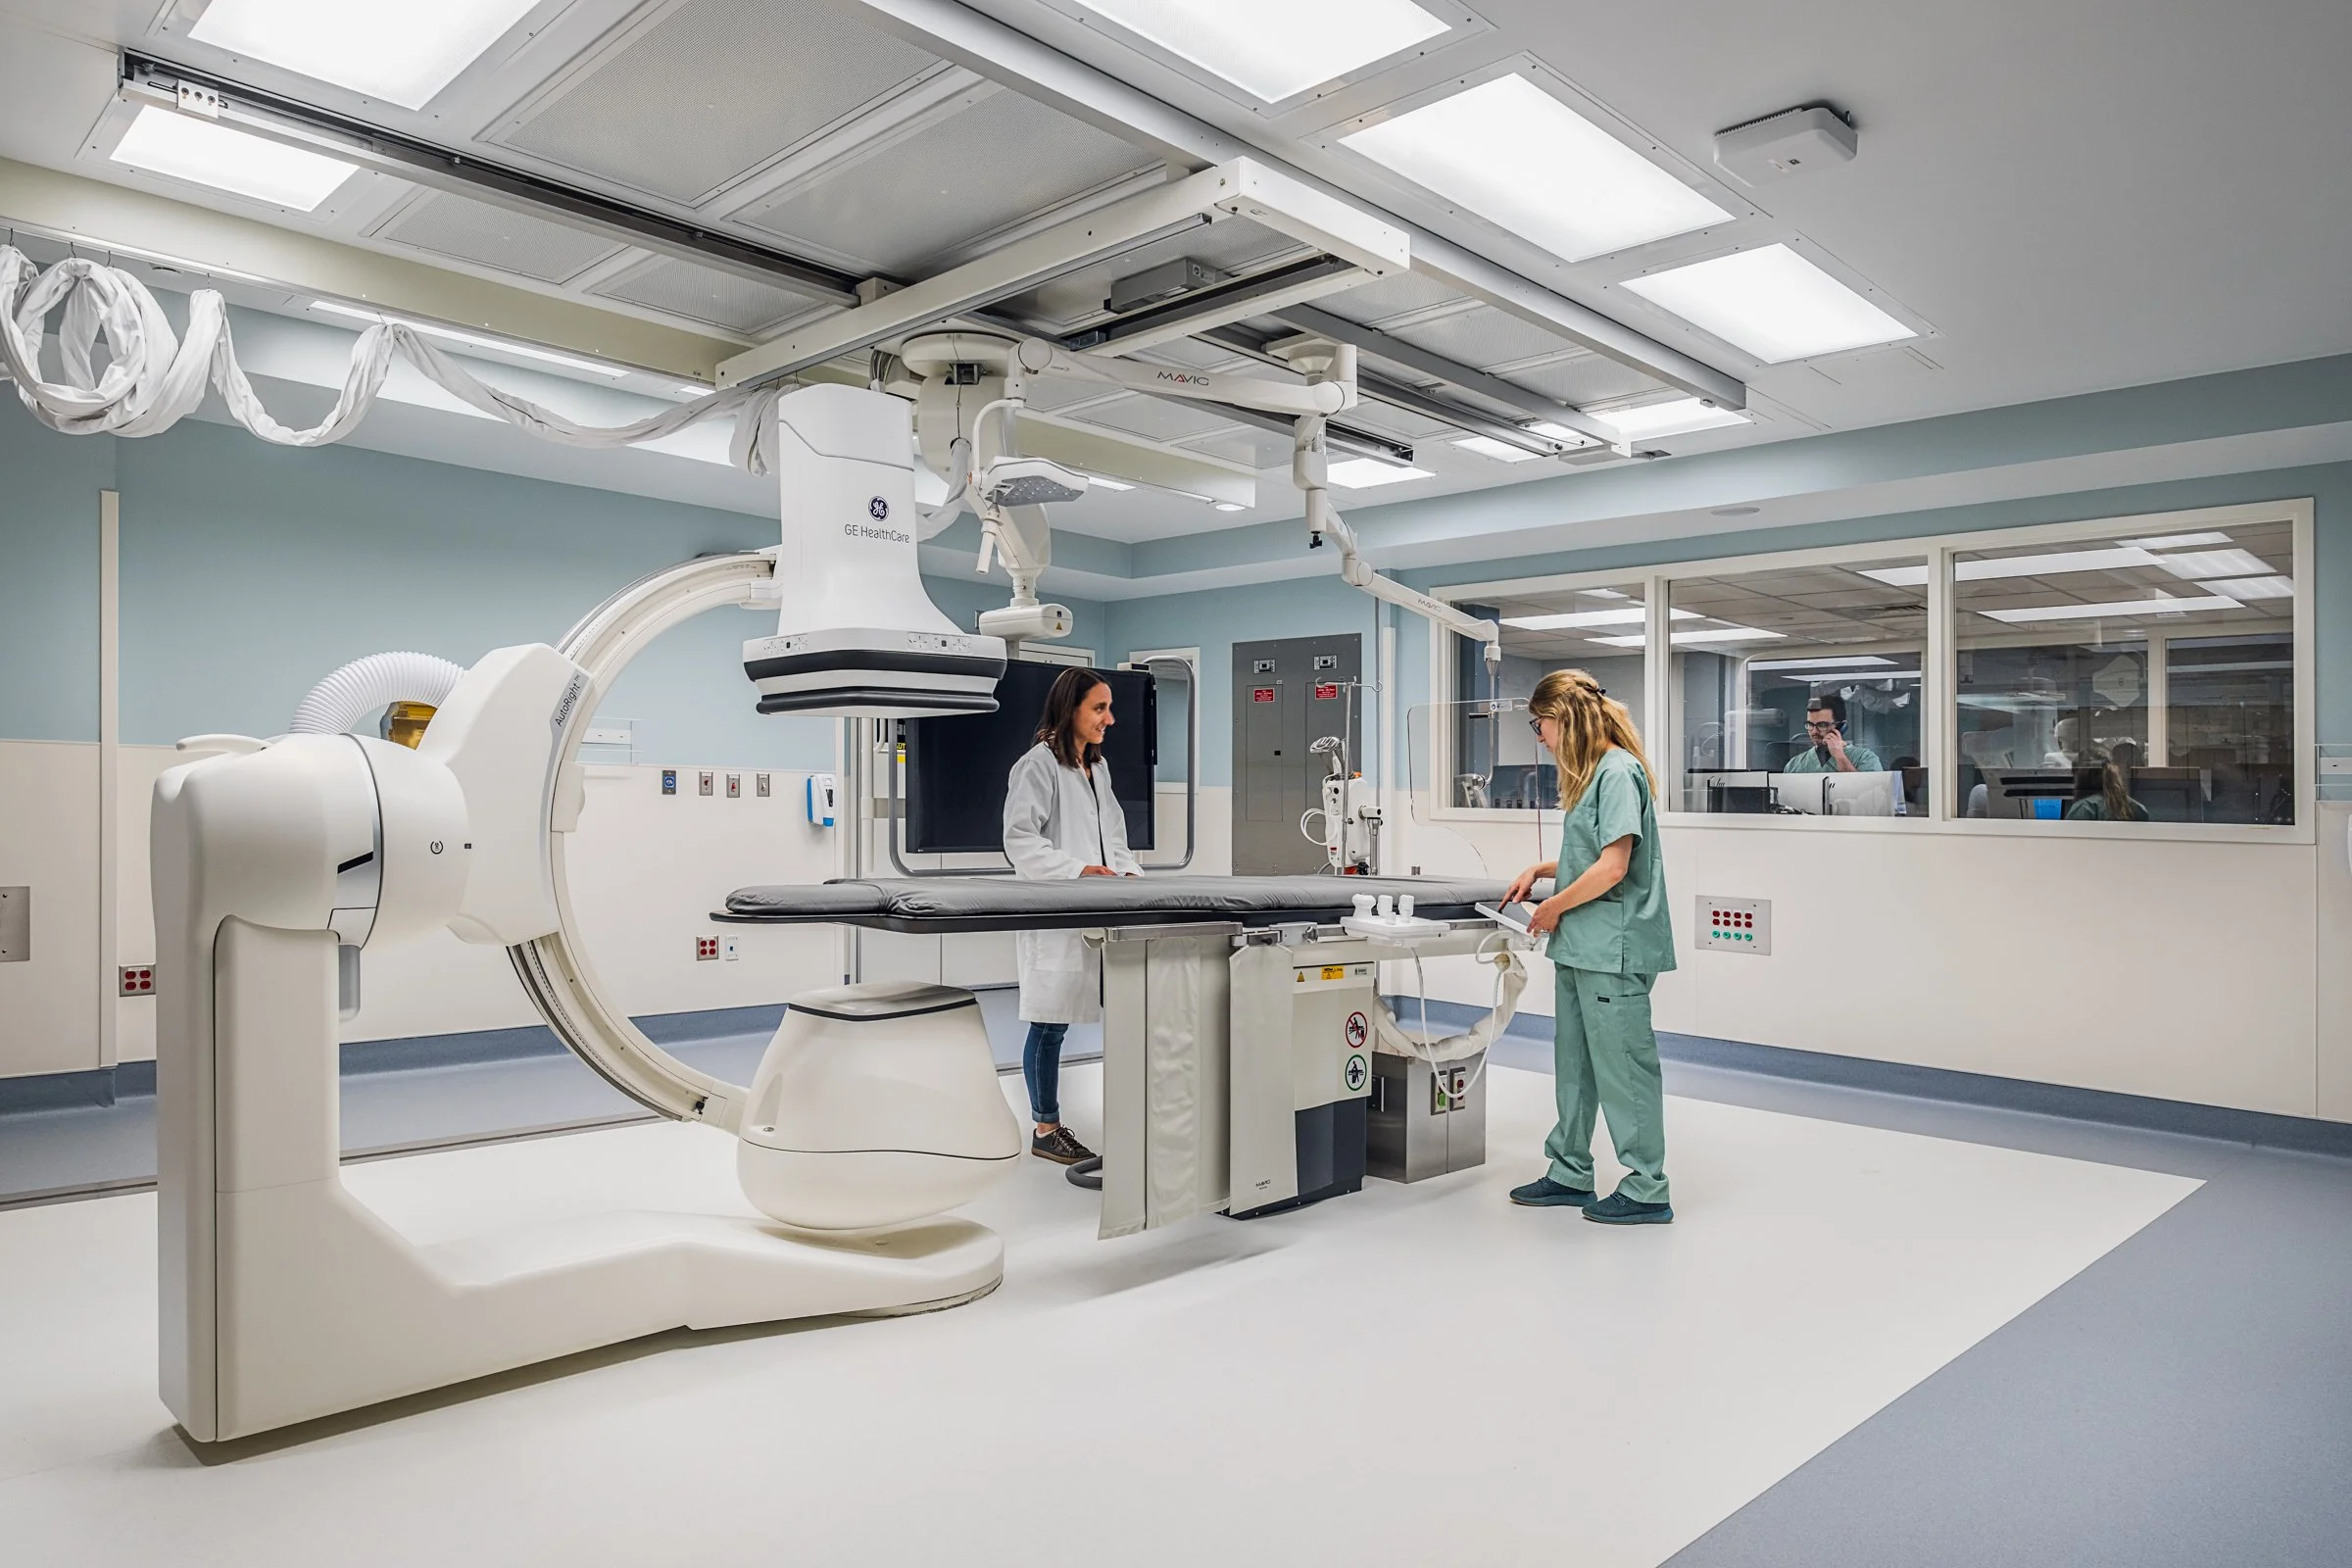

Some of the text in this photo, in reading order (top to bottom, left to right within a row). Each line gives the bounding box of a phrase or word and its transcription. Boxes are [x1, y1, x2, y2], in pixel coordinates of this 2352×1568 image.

[1156, 370, 1210, 387] MAVIG
[844, 523, 910, 544] GE HealthCare
